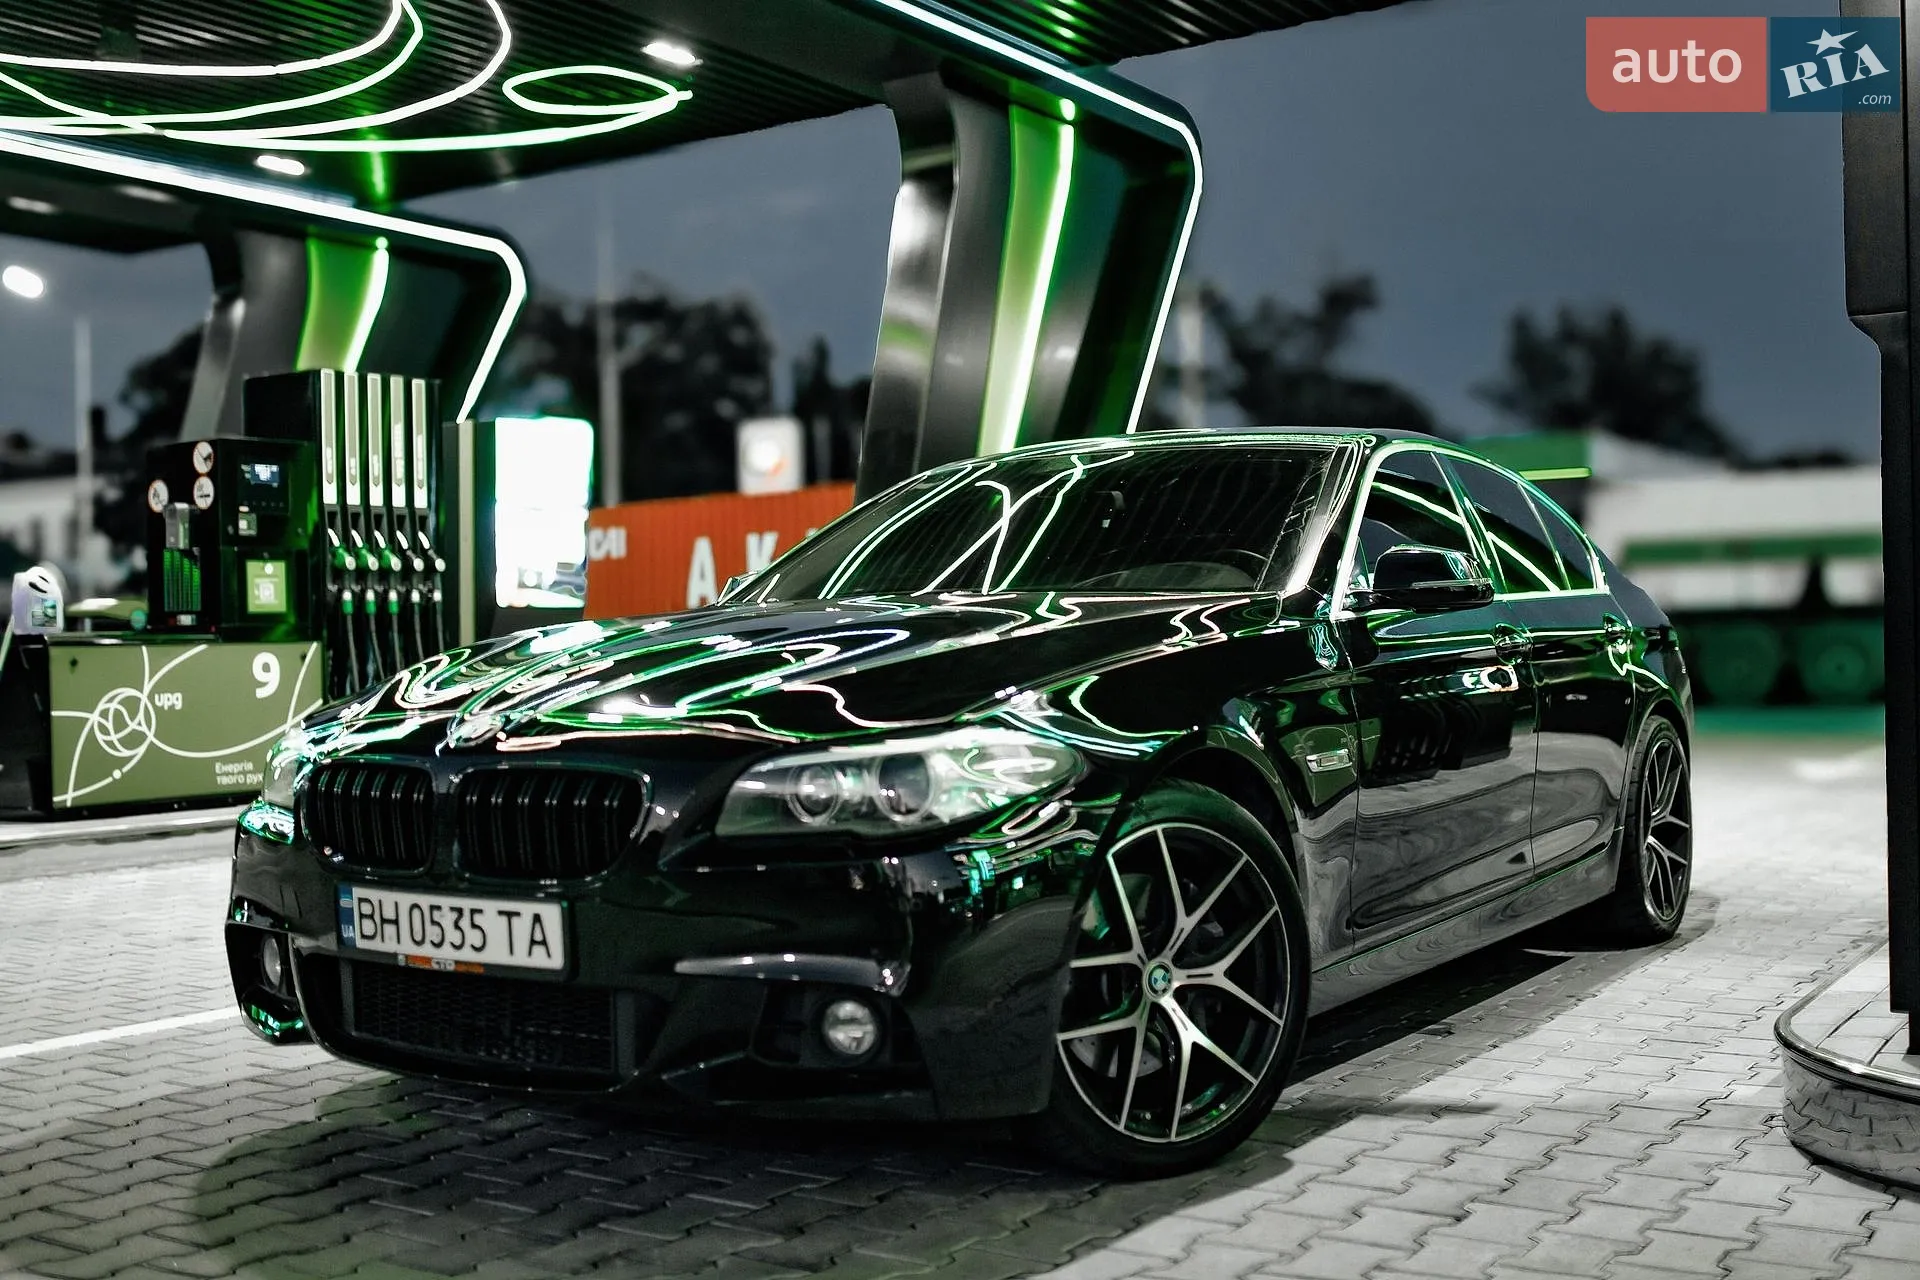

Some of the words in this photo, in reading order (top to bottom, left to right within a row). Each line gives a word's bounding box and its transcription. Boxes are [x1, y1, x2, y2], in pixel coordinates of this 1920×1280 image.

[252, 651, 280, 699] 9
[154, 692, 183, 710] upg
[341, 923, 355, 938] UA
[357, 897, 401, 944] BH
[408, 902, 487, 953] 0535
[497, 909, 552, 960] TA
